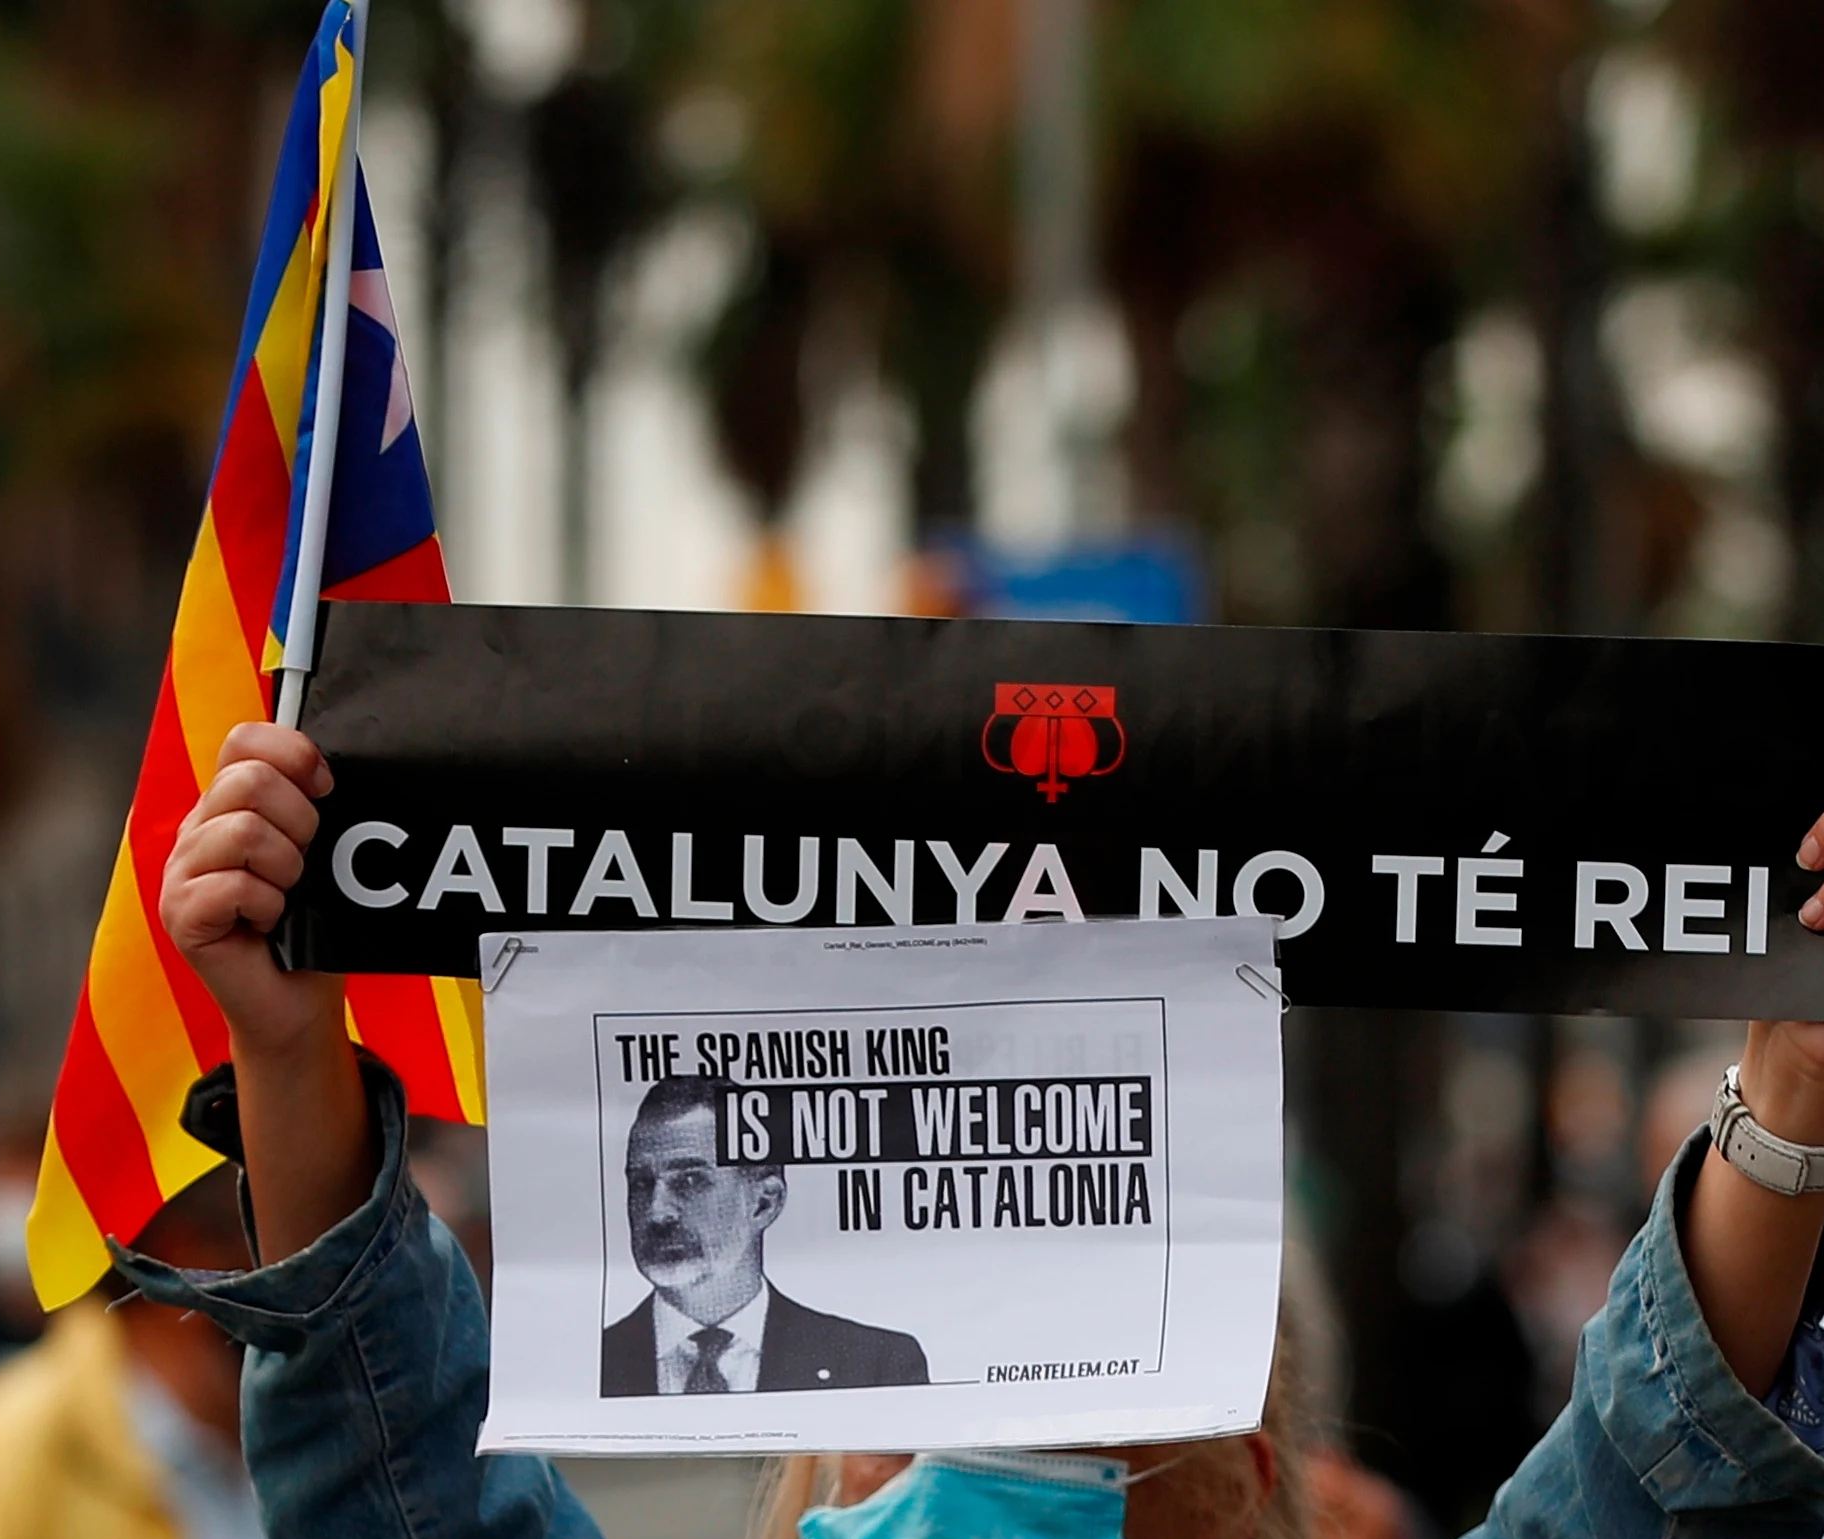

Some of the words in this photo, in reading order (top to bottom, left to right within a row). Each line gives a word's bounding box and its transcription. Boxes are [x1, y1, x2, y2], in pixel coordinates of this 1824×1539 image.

[331, 820, 1085, 926] CATALUNYA
[1138, 846, 1325, 941] NO
[1371, 830, 1524, 947] TÉ
[1574, 860, 1770, 955] REI
[614, 1032, 680, 1083] THE
[696, 1029, 851, 1081] SPANISH
[865, 1025, 950, 1078] KING
[725, 1090, 771, 1161] IS
[791, 1088, 888, 1159] NOT
[910, 1082, 1145, 1157] WELCOME
[837, 1168, 883, 1232] IN
[902, 1162, 1153, 1231] CATALONIA
[985, 1358, 1141, 1383] ENCARTELLEM.CAT
